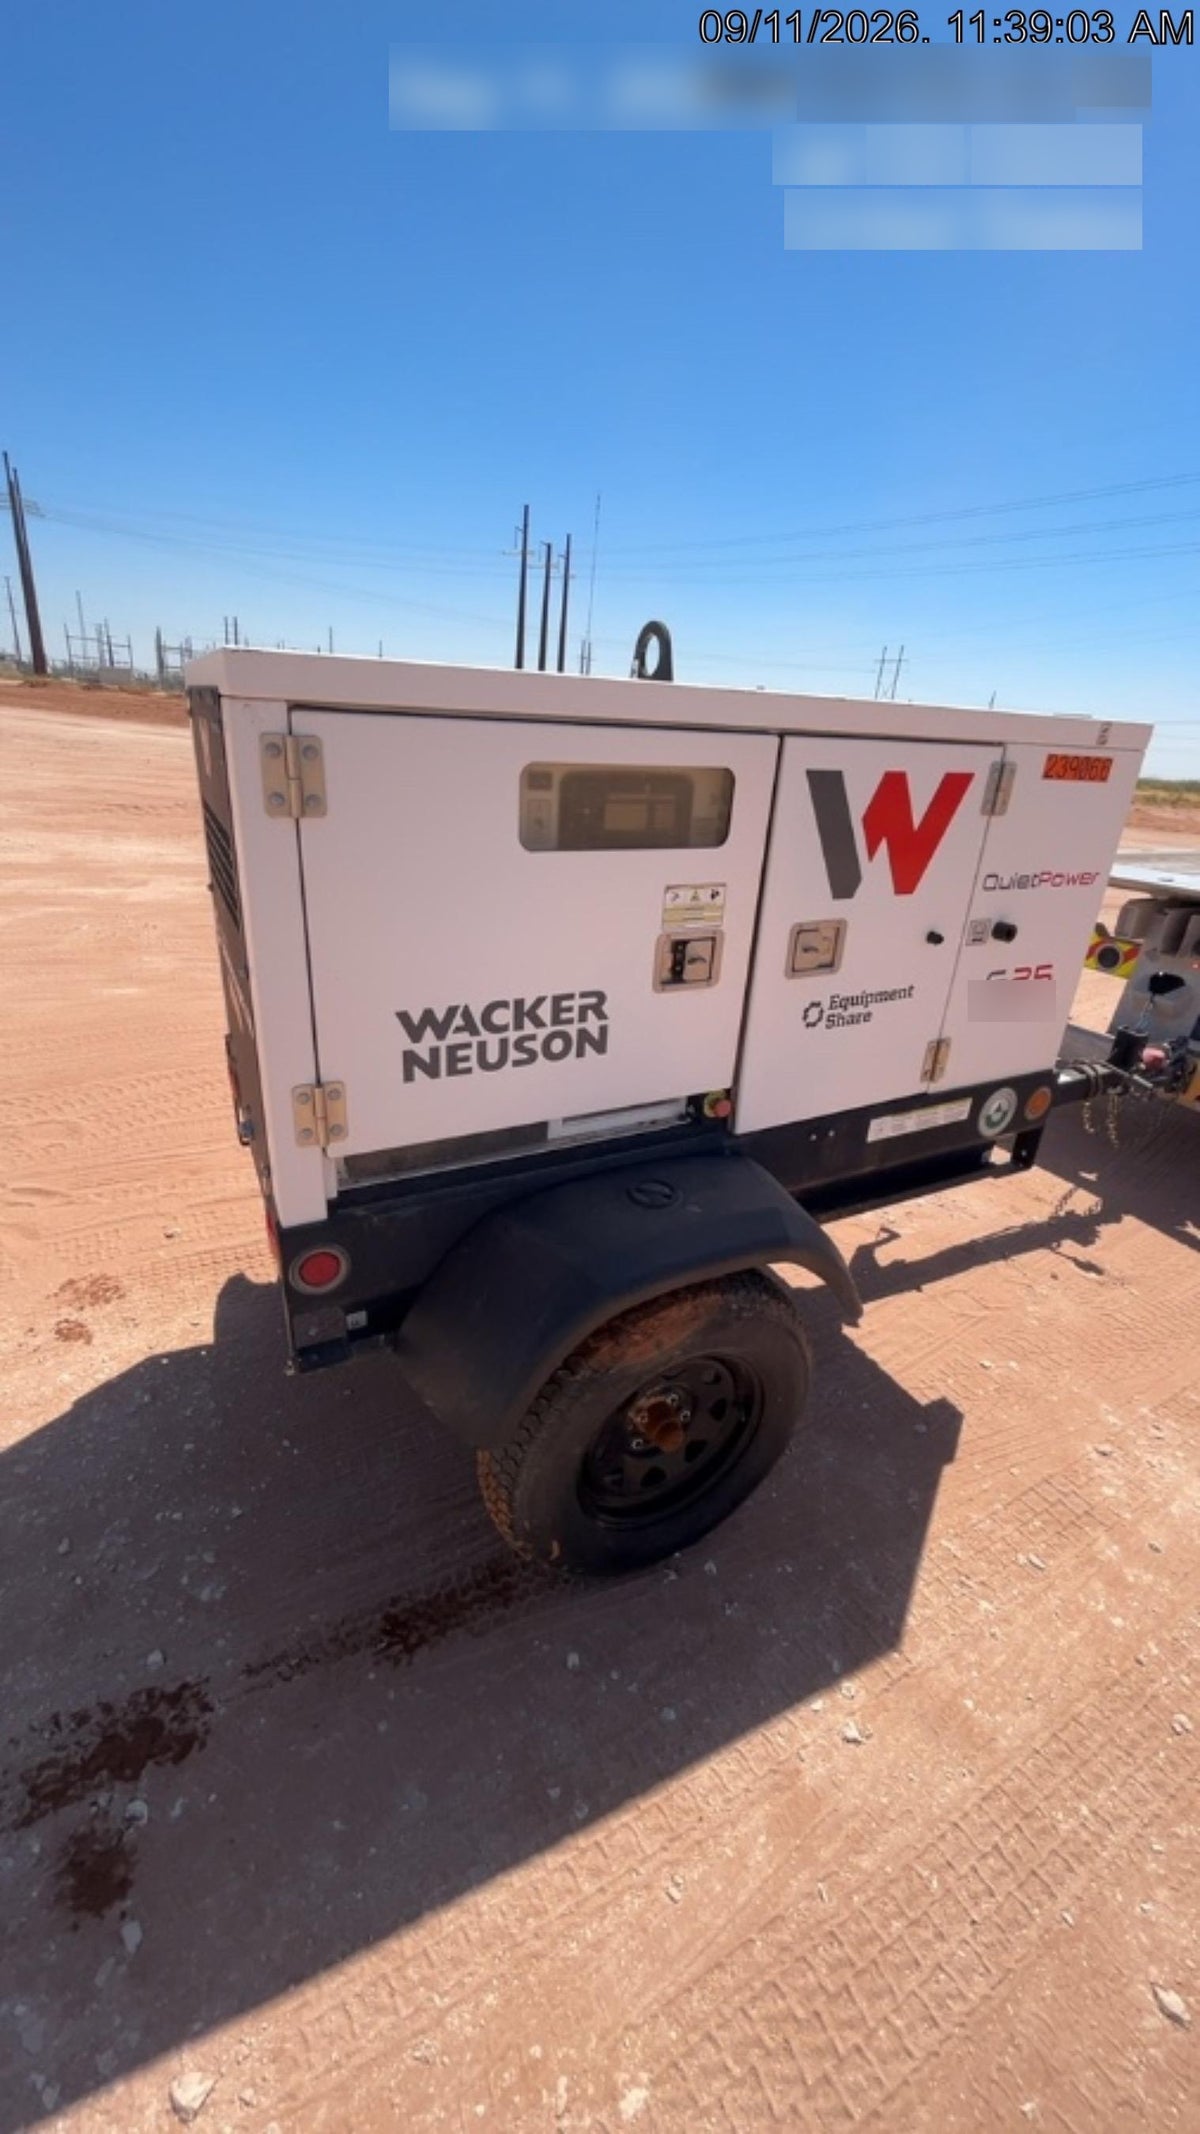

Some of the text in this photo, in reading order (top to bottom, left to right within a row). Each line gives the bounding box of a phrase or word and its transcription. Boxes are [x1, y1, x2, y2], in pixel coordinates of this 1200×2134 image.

[983, 869, 1100, 892] QuietPower
[827, 984, 915, 1011] Equipment
[395, 990, 609, 1045] WACKER
[825, 1011, 873, 1029] Share
[402, 1024, 608, 1084] NEUSON
